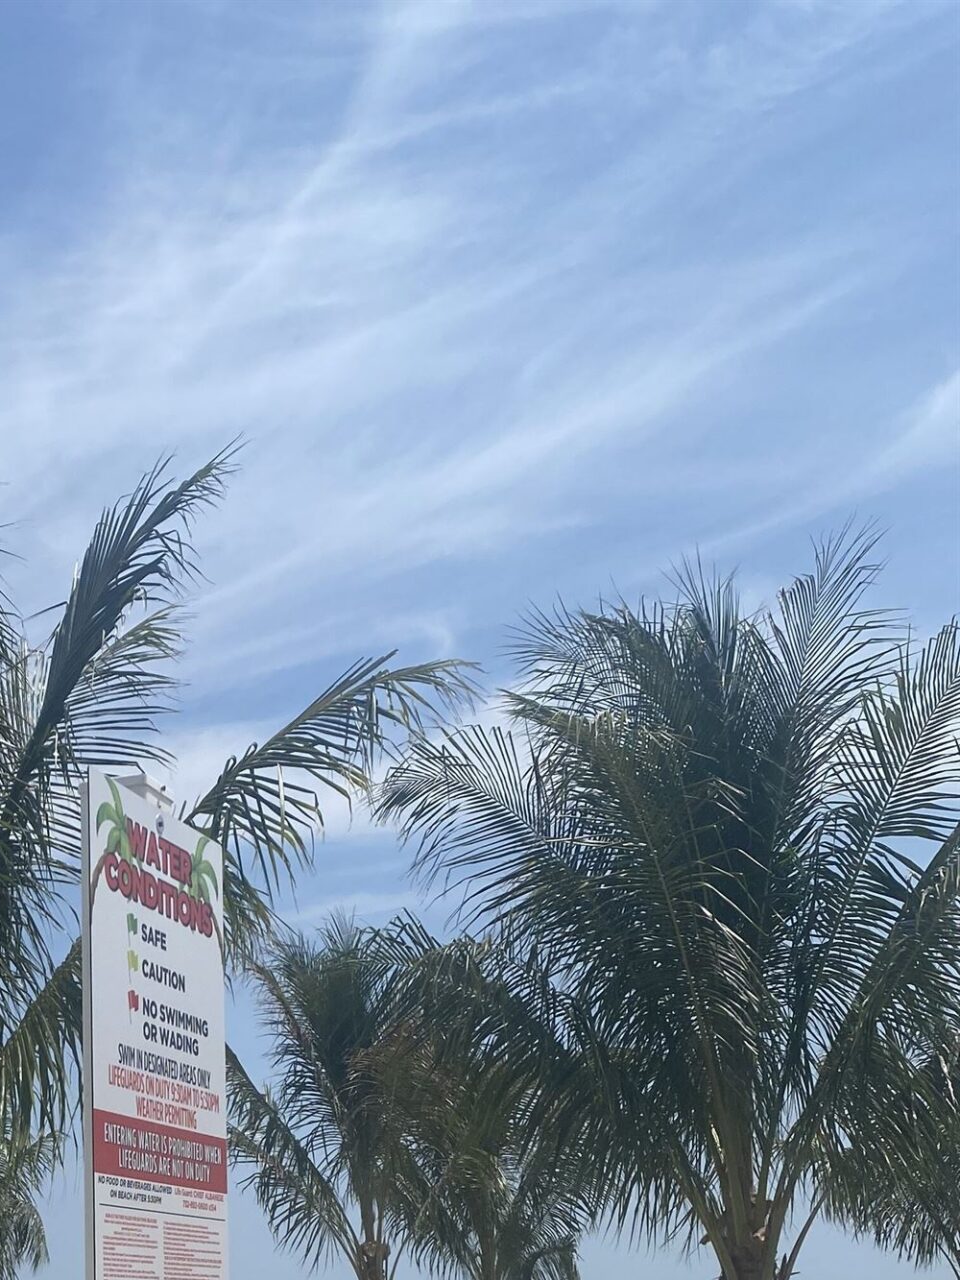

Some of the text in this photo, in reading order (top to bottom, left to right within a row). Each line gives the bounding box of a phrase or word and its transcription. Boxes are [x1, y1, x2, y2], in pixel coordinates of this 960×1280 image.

[126, 815, 192, 888] WATER
[104, 852, 213, 938] CONDITIONS
[141, 923, 167, 951] SAFE
[142, 959, 186, 993] CAUTION
[142, 997, 208, 1037] NO SWIMMING
[143, 1021, 199, 1056] OR WADING
[118, 1043, 211, 1089] SWIM IN DESIGNATED AREAS ONLY
[108, 1064, 145, 1093] LIFEGUARDS
[145, 1074, 155, 1096] ON
[155, 1077, 170, 1100] DUTY
[192, 1088, 200, 1108] TO
[136, 1095, 197, 1129] WEATHER PERMITTING
[104, 1122, 222, 1165] ENTERING WATER IS PROHIBITED WHEN
[118, 1148, 211, 1183] LIFEGUARDS ARE NOT ON DUTY
[98, 1175, 172, 1194] NO FOOD OR BEVERAGES ALLOWED
[110, 1189, 117, 1198] ON
[117, 1190, 132, 1200] BEACH
[133, 1193, 147, 1202] AFTER
